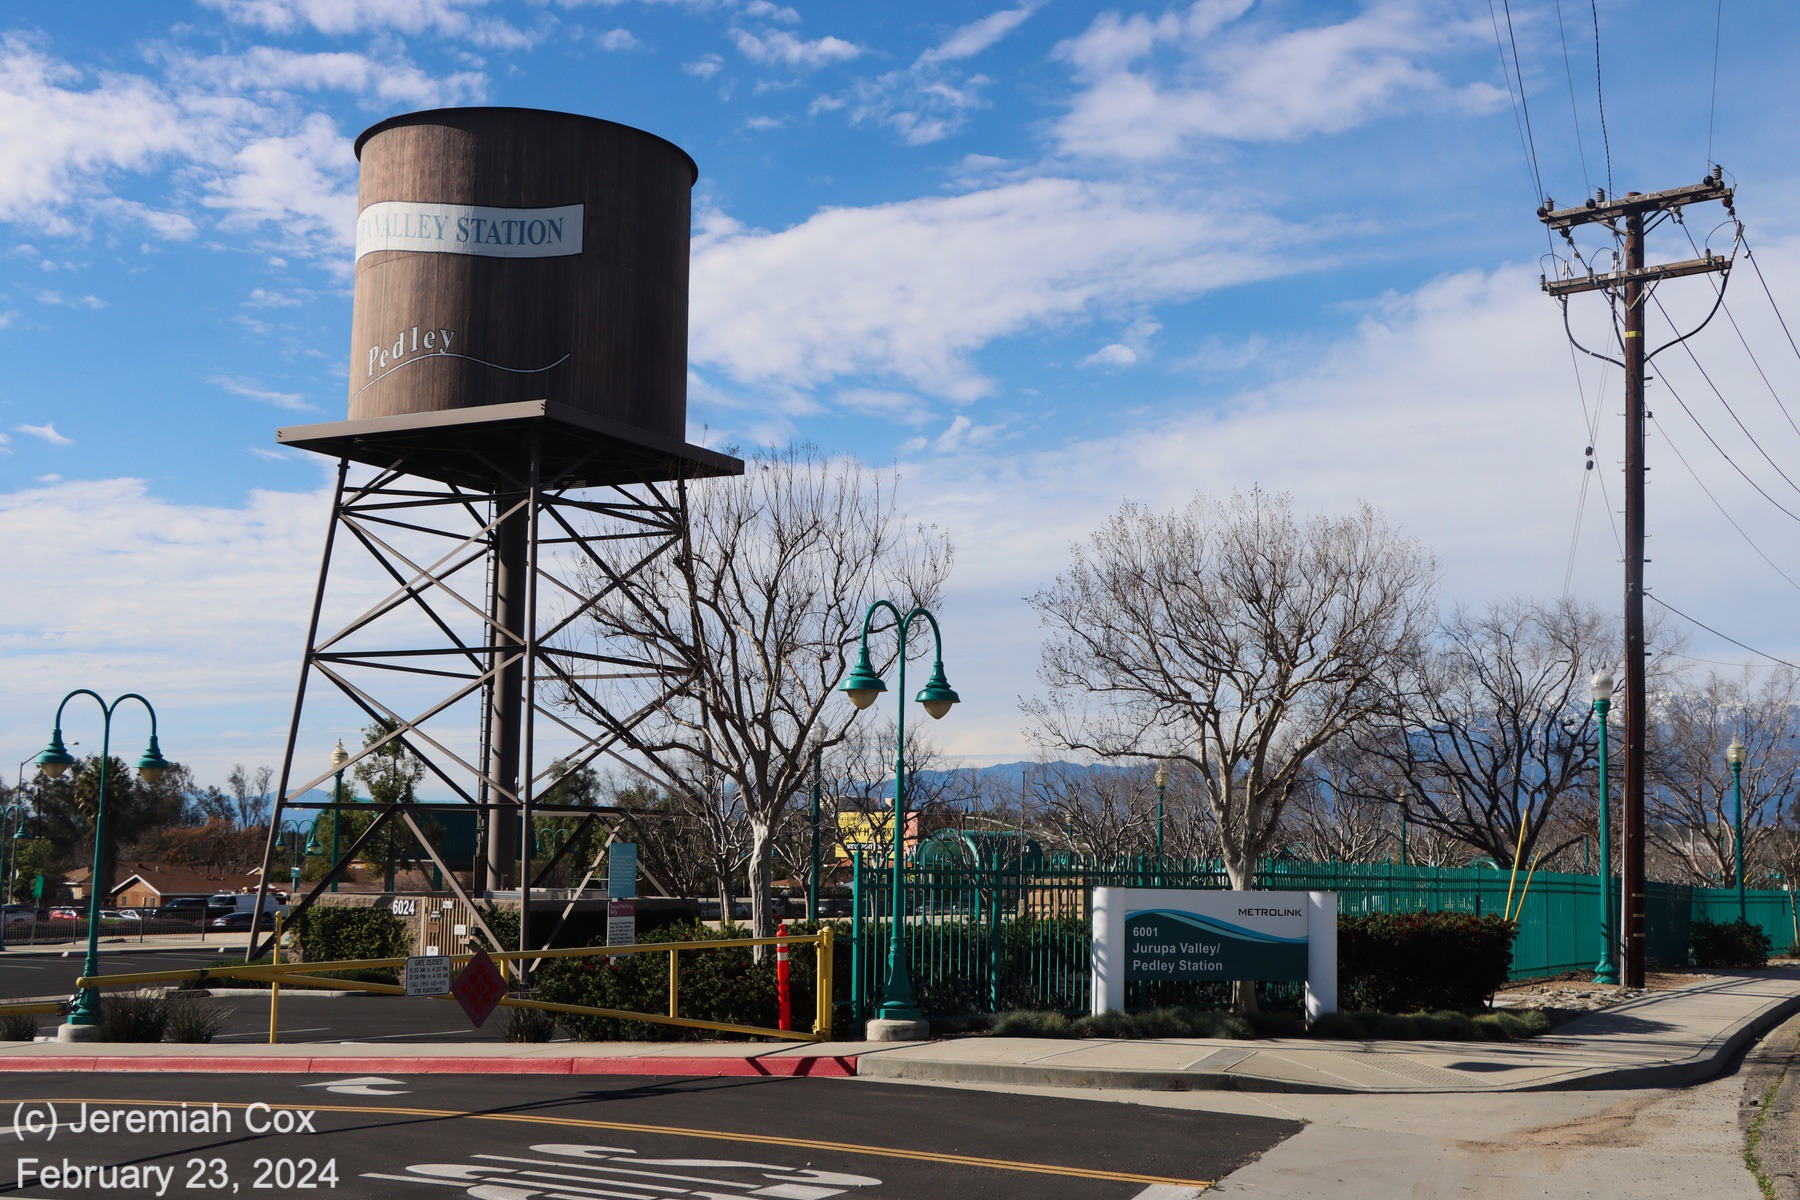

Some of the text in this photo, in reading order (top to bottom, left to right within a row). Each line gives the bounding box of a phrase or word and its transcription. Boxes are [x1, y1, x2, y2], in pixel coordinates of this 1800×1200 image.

[375, 213, 449, 241] VALLEY
[456, 216, 565, 245] STATION
[368, 326, 456, 377] Pedley
[392, 900, 415, 915] 6024
[1238, 908, 1302, 917] METROLINK
[1132, 926, 1159, 937] 6001
[1132, 942, 1221, 957] Jurupa Valley/
[1132, 959, 1223, 974] Pedley Station
